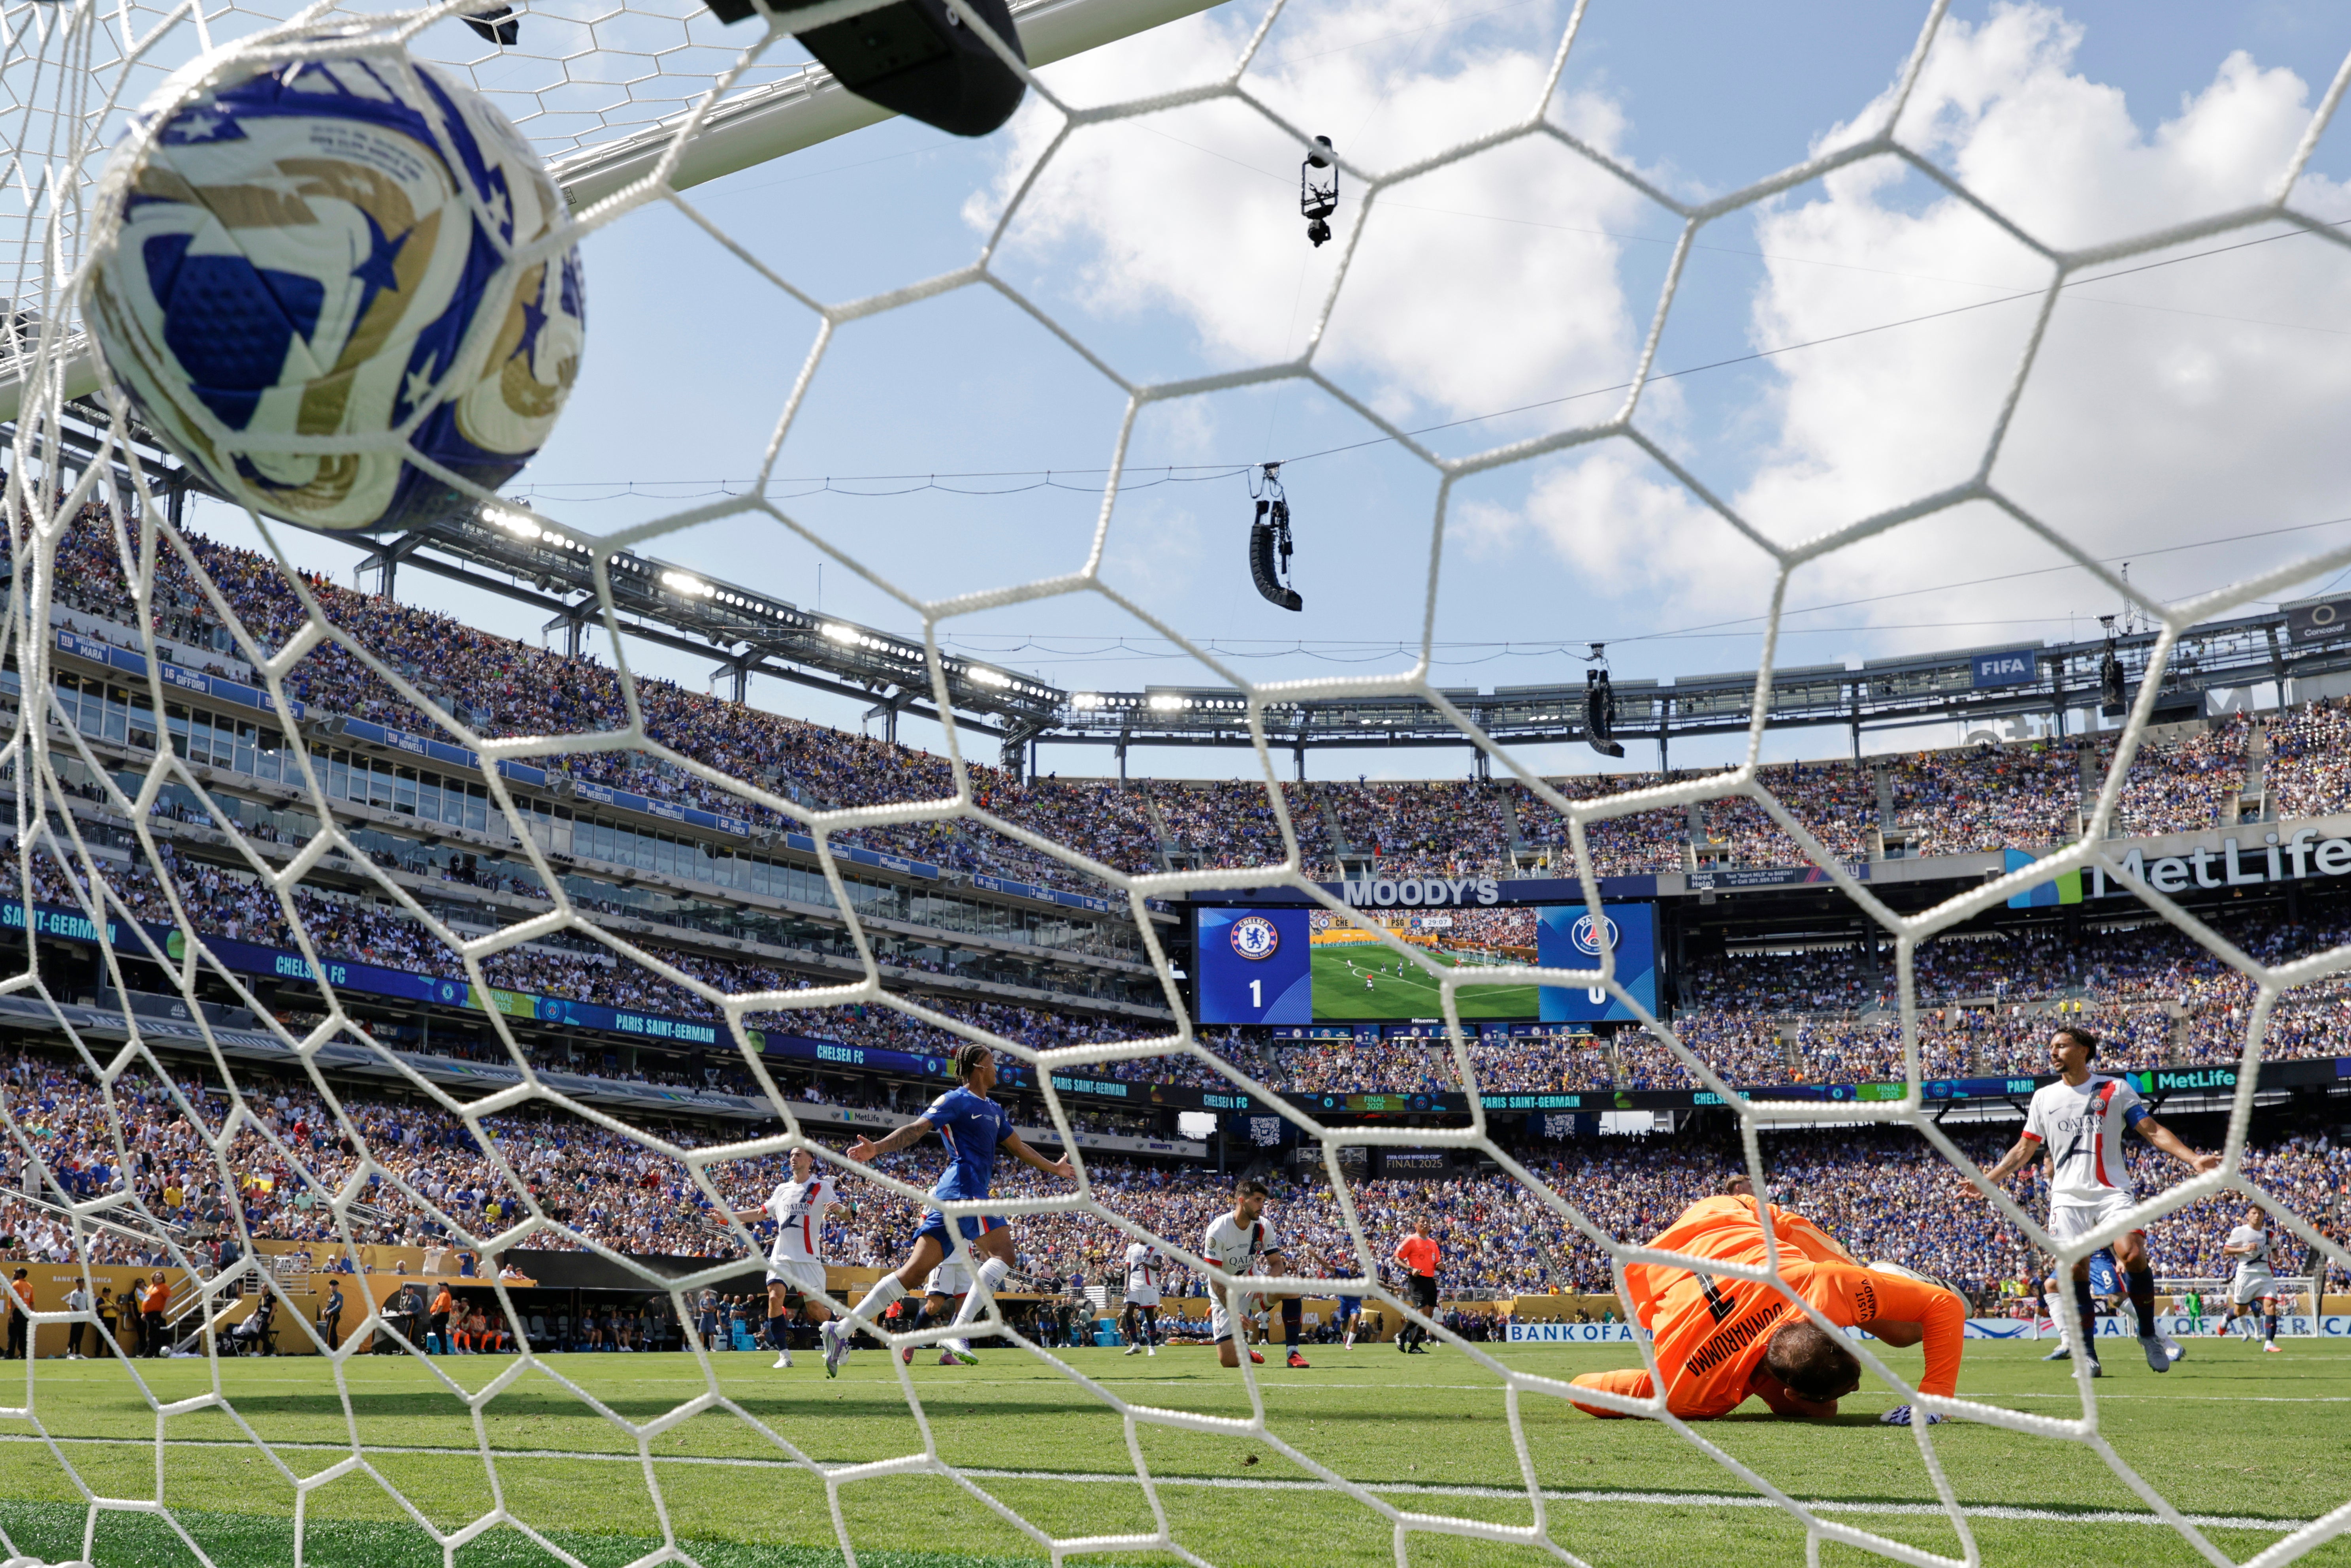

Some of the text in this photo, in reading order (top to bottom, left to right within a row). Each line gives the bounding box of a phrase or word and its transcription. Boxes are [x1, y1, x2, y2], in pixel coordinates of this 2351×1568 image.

[2304, 623, 2345, 636] Concacaf
[75, 636, 106, 651] WELLINGTON
[80, 646, 103, 661] MARA
[165, 667, 174, 679] 16
[1981, 658, 2025, 676] FIFA
[183, 670, 199, 680] FRANK
[176, 675, 205, 691] GIFFORD
[399, 739, 423, 753] HOWELL
[577, 784, 586, 793] 29
[586, 789, 611, 803] WEBSTER
[649, 802, 656, 811] 81
[656, 807, 682, 820] ROBUSTELLI
[721, 819, 729, 828] 22
[730, 825, 745, 835] LYNCH
[881, 856, 887, 865] 40
[887, 861, 909, 872] MORRISON
[2093, 828, 2351, 898] MetLife
[985, 881, 998, 890] TITTLE
[1692, 880, 1715, 888] Help?
[3, 904, 116, 943] SAIT-GERMAN
[1238, 918, 1269, 929] CHELSEA
[1579, 916, 1609, 927] PAS
[1238, 948, 1259, 958] FOOTBALL
[330, 965, 346, 984] FC
[490, 990, 514, 1003] FINAL
[1249, 979, 1261, 1008] 1
[616, 1013, 715, 1043] PARIS SAINT-GERMAIN
[187, 1028, 283, 1049] SADIUM
[816, 1044, 864, 1064] CHELSEA FC
[2159, 1069, 2236, 1089] MetLife
[1052, 1076, 1127, 1097] PARIS SAINT-GERMAIN
[680, 1095, 732, 1107] MetLife
[1204, 1094, 1248, 1109] CHELSEA FC
[1481, 1096, 1580, 1109] PARIS SAINT-GERMAIN
[1694, 1092, 1728, 1105] CHELS
[854, 1112, 880, 1123] MetLife
[2058, 1115, 2102, 1132] QATAR
[2073, 1126, 2102, 1137] AIRWAYS
[1386, 1159, 1443, 1168] FINAL 2025
[784, 1203, 809, 1212] QATAR
[934, 1267, 942, 1280] 17
[2102, 1270, 2112, 1286] 8
[1861, 1279, 1874, 1321] WANDA
[1855, 1293, 1868, 1321] VISIT
[1302, 1312, 1319, 1324] VISA
[1512, 1325, 1575, 1340] BANK
[1583, 1325, 1611, 1340] OF
[1686, 1302, 1783, 1377] DONNARUMMA
